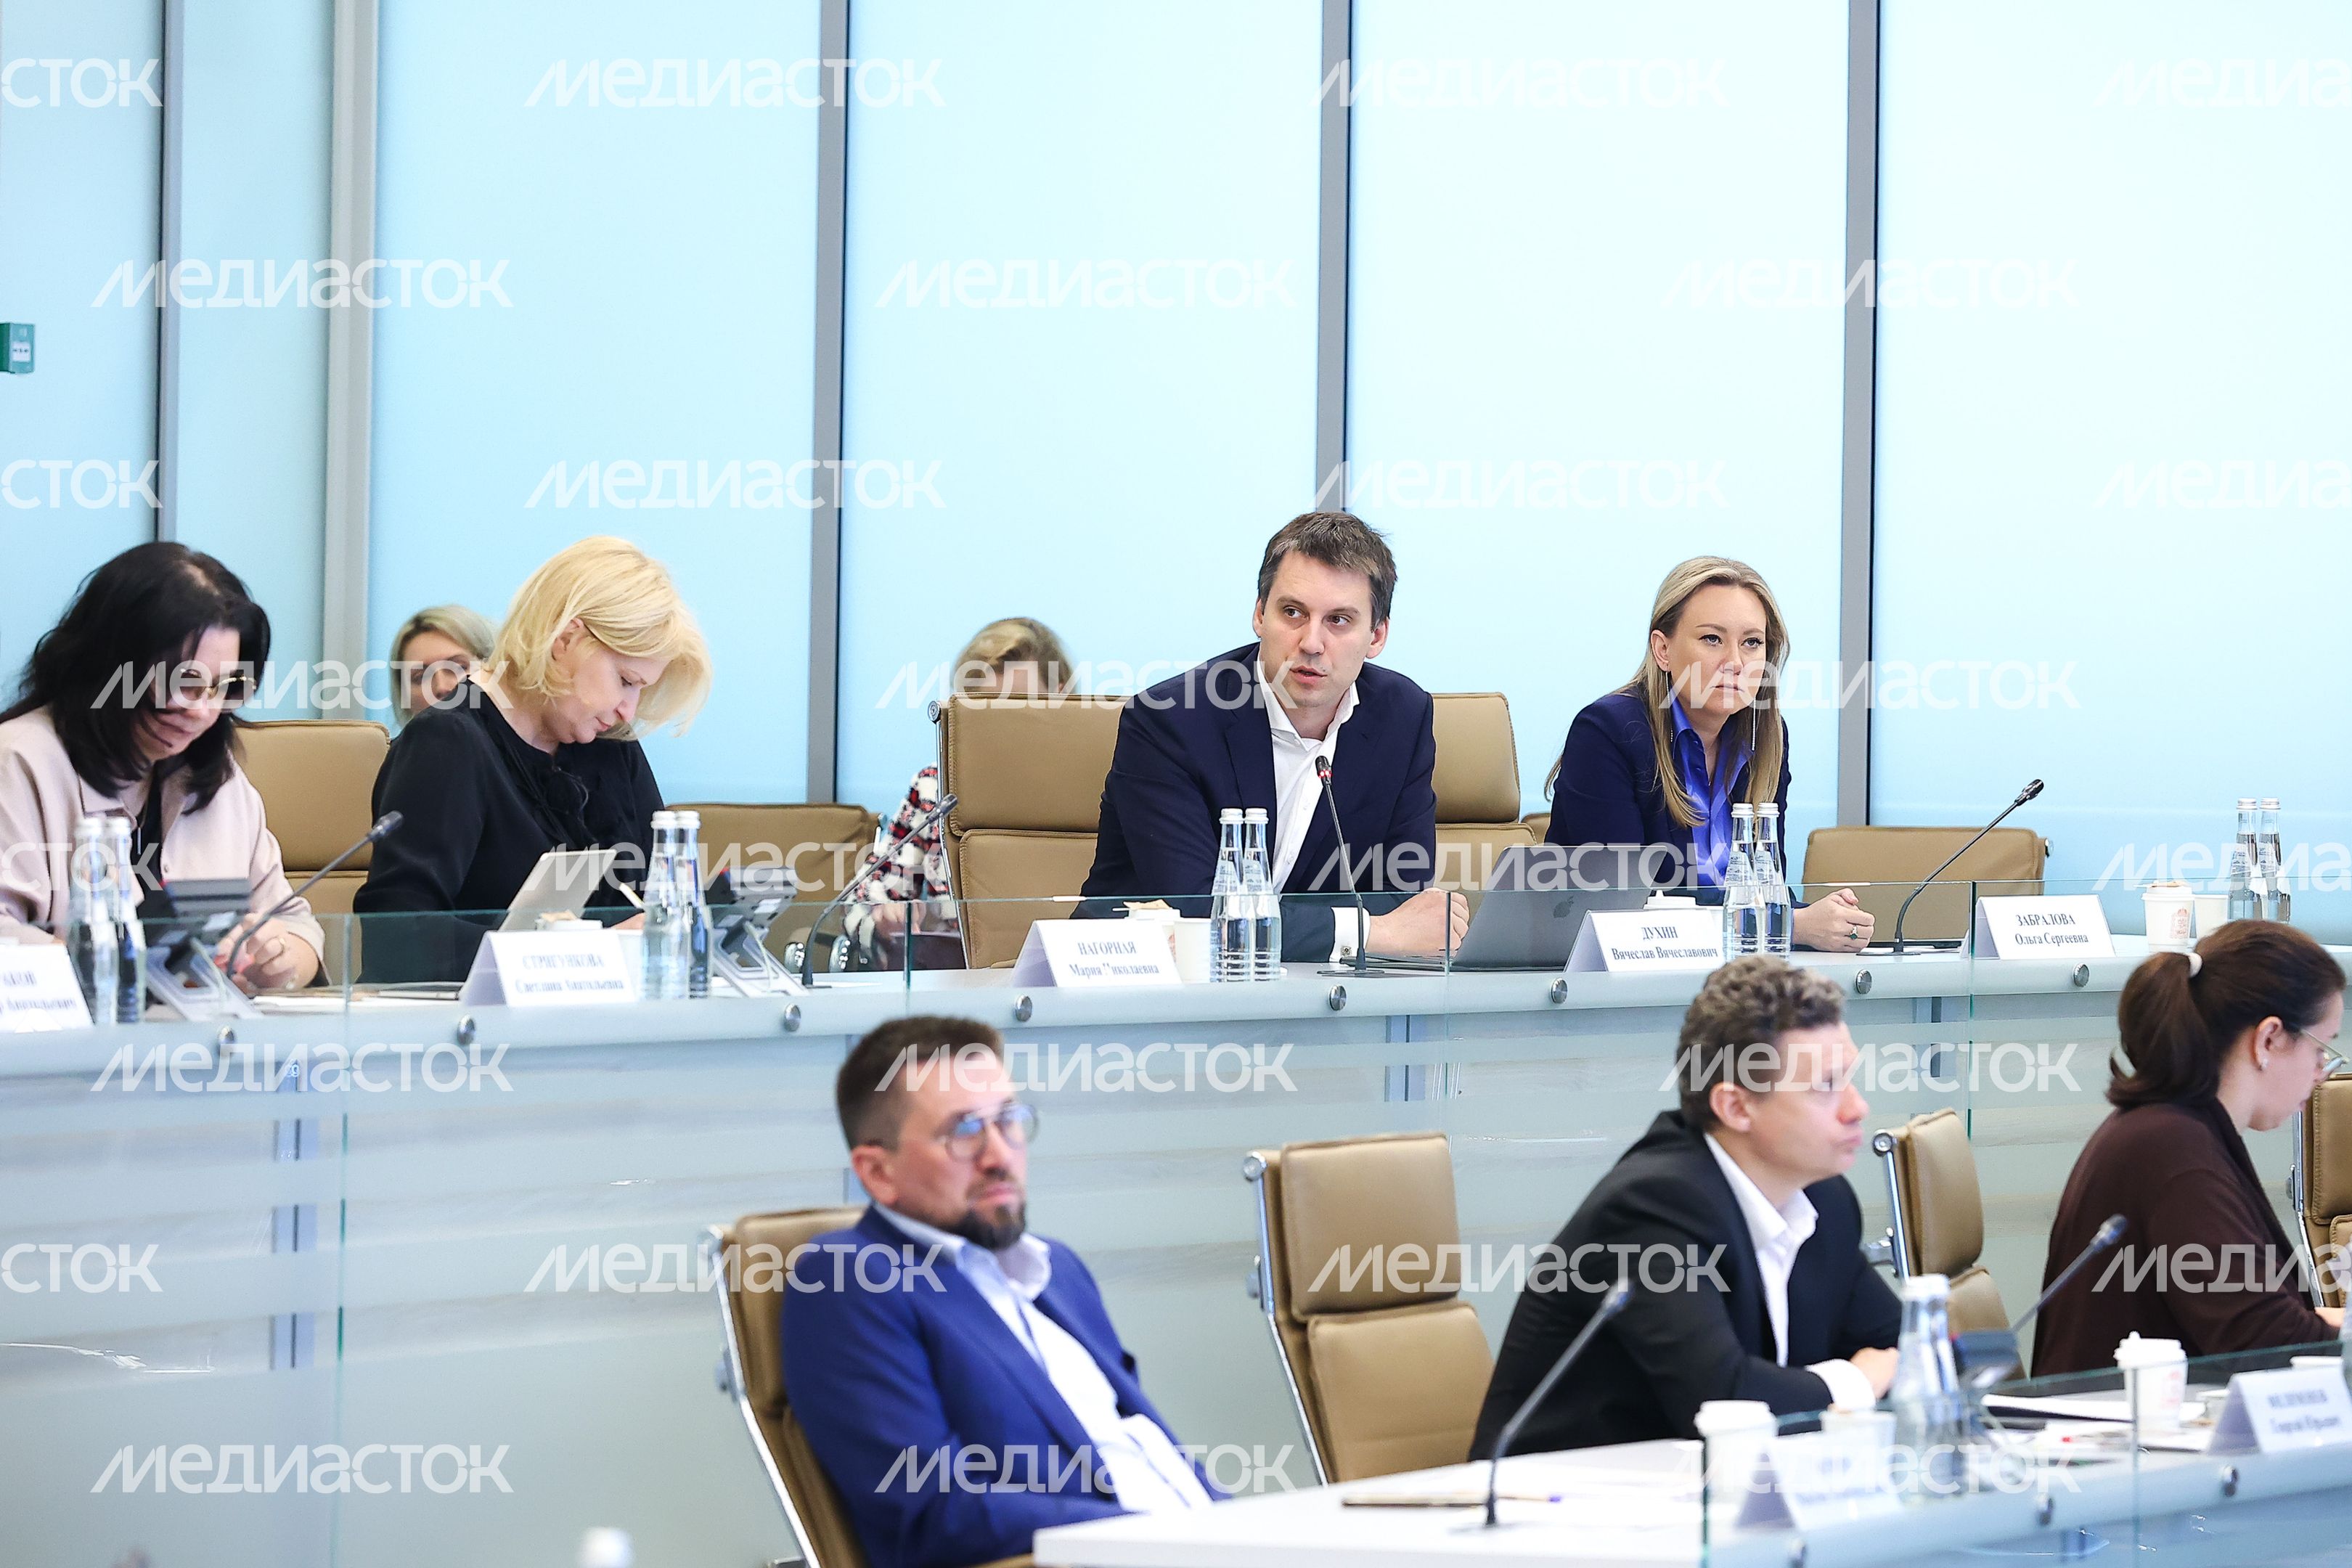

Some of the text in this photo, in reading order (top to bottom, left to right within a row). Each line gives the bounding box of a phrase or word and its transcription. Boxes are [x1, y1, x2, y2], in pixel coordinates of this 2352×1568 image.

[2015, 913, 2075, 926] ЗАБРАЛОВА
[1641, 926, 1678, 940] ДУХИН
[2015, 932, 2088, 947] Ольга Сергеевна
[1077, 942, 1137, 955] НАГОРНАЯ
[1612, 947, 1718, 960] Вячеслав Вячеславович
[1069, 964, 1103, 979] Мария
